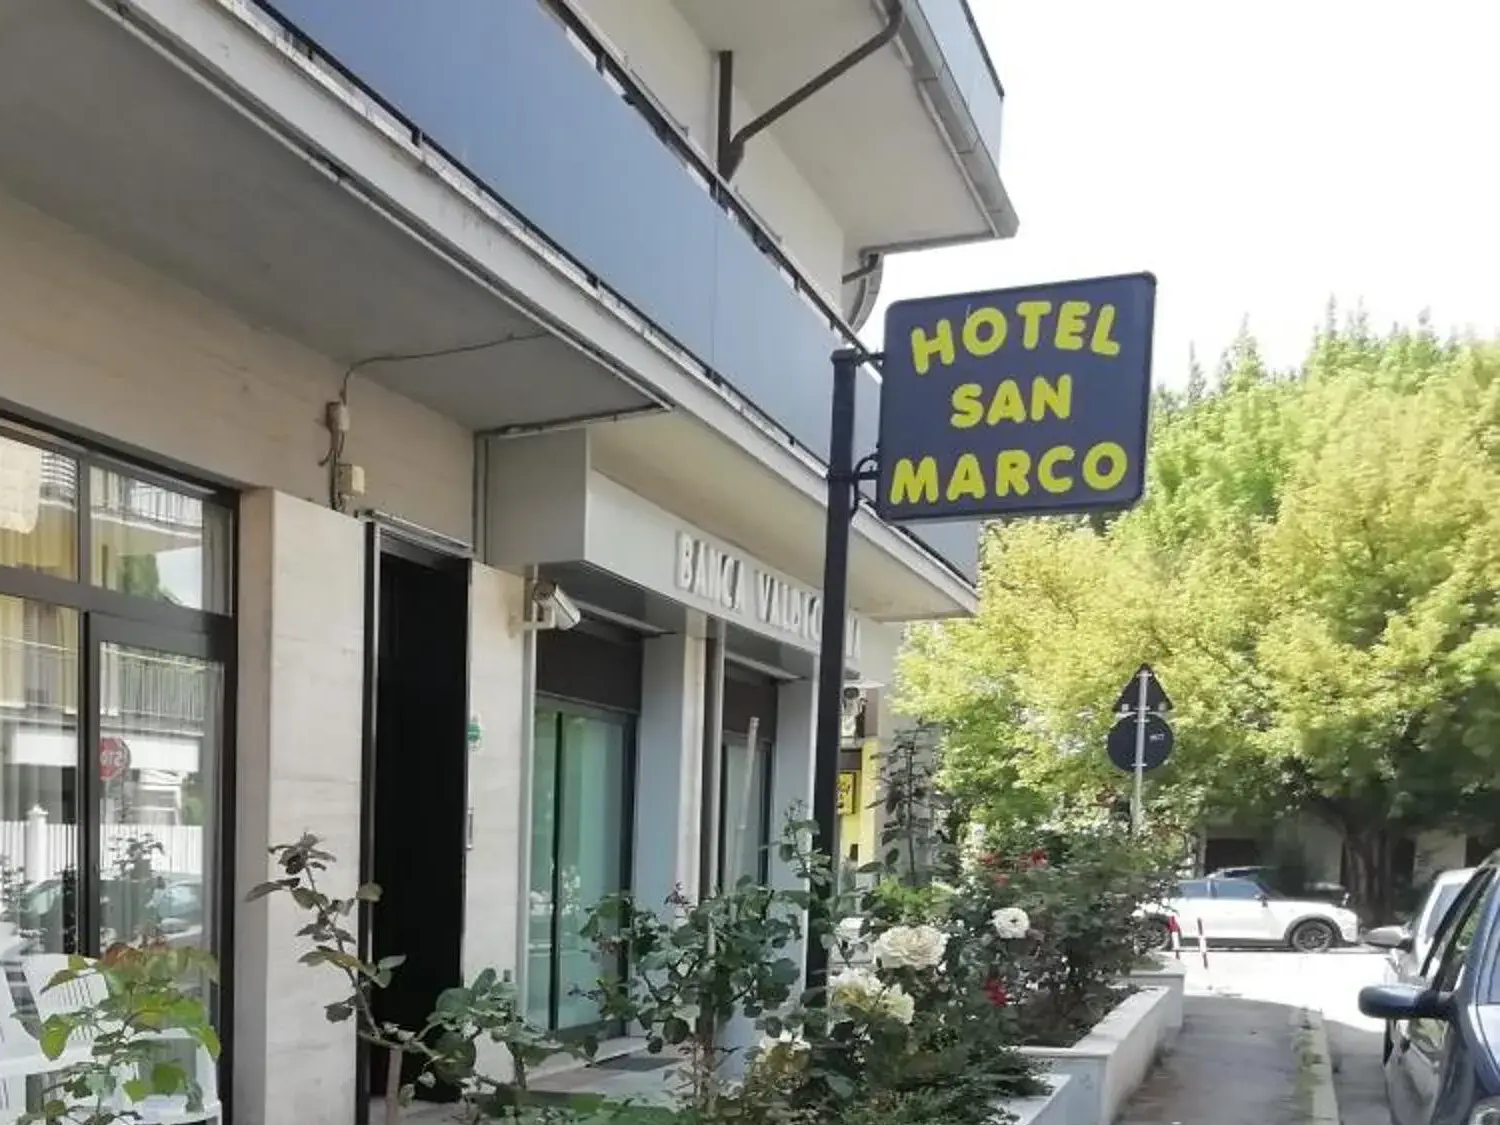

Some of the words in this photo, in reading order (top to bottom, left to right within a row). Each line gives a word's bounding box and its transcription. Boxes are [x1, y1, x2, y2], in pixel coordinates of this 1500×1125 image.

[910, 301, 1121, 375] HOTEL
[950, 374, 1073, 429] SAN
[890, 441, 1128, 505] MARCO
[678, 530, 744, 614] BANCA
